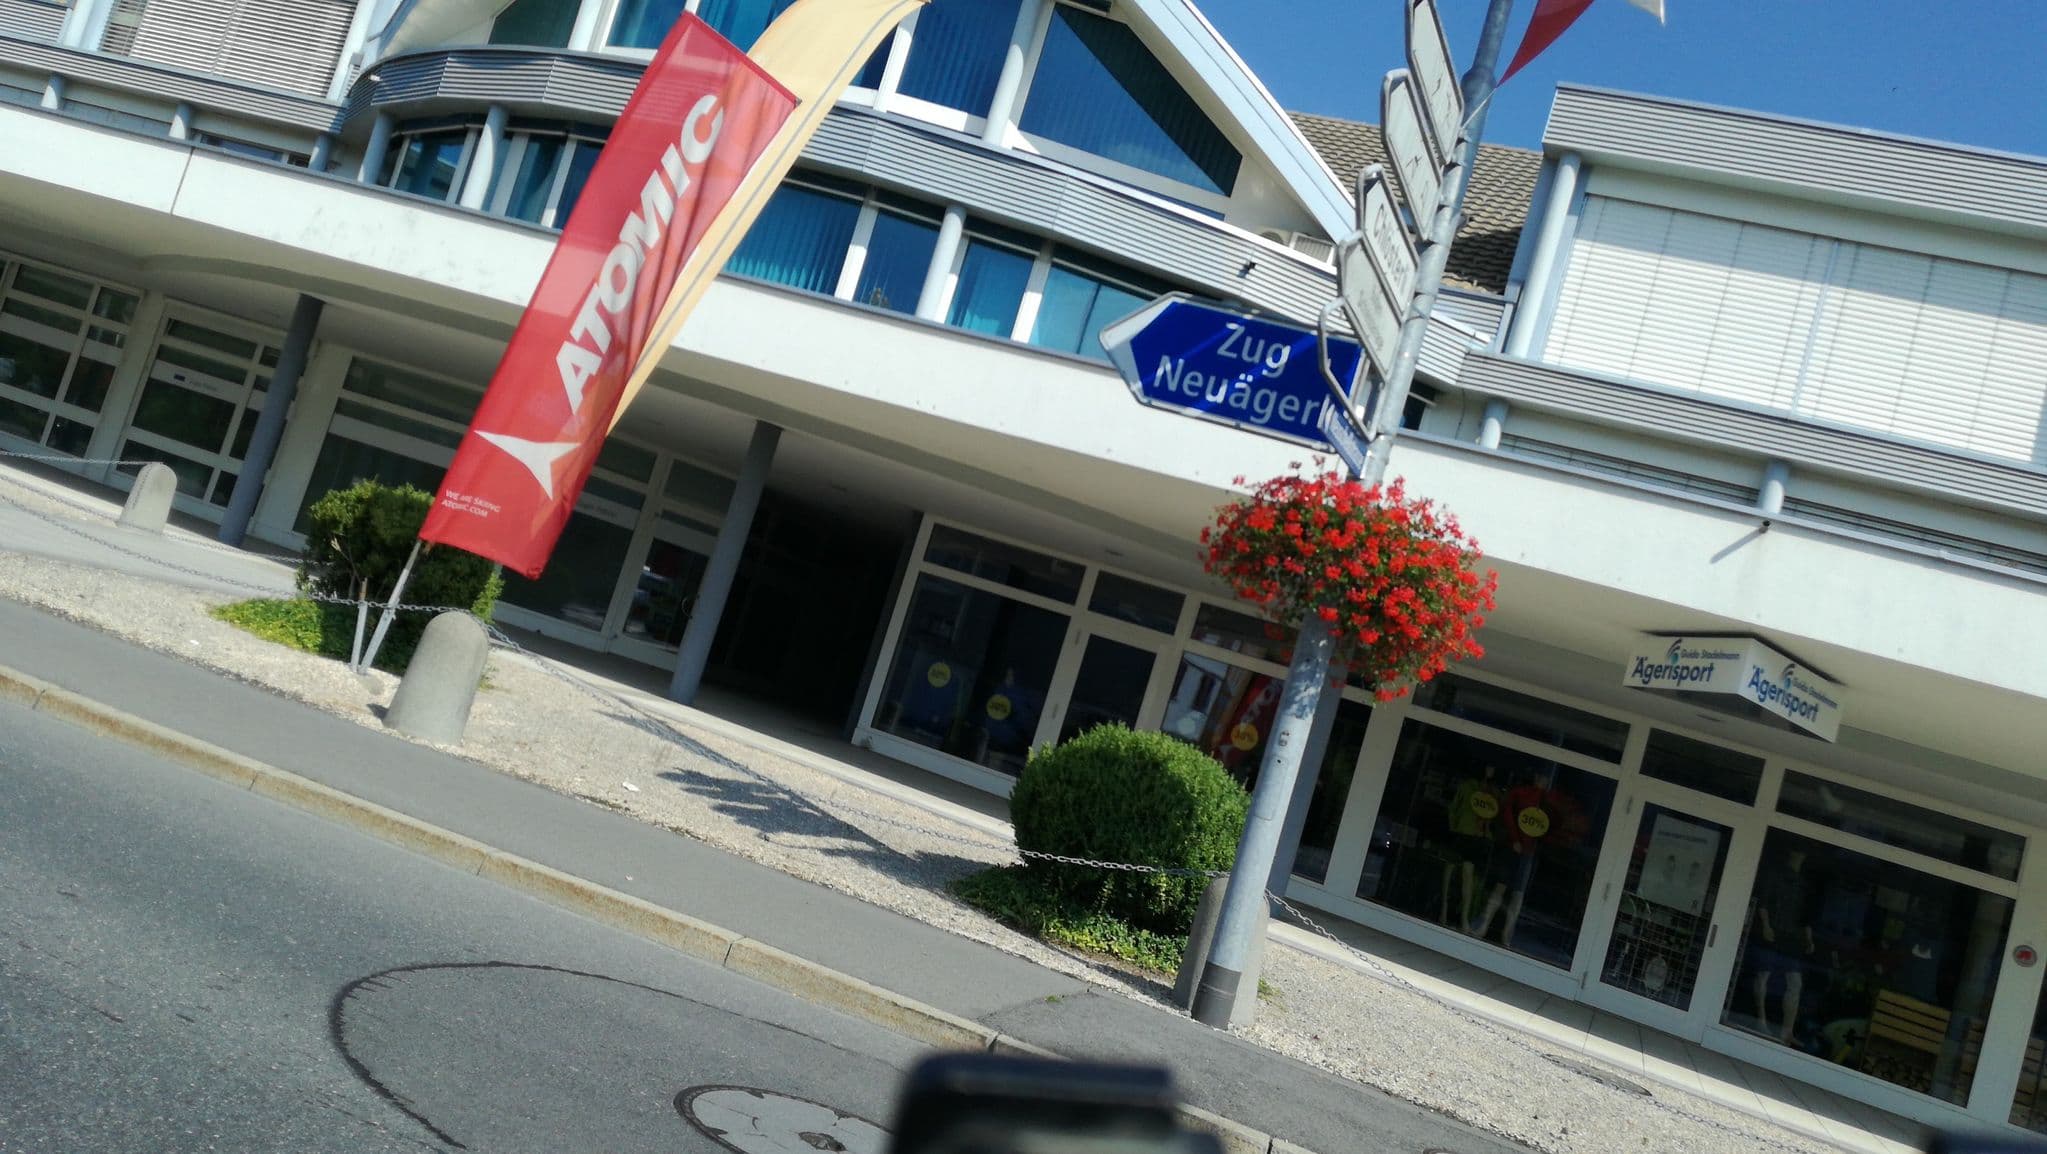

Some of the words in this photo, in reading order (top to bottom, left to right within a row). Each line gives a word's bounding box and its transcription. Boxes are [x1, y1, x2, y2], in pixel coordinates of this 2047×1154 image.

[555, 94, 725, 415] ATOMIC
[1217, 322, 1291, 378] Zug
[1631, 656, 1715, 686] Ägerisport
[1747, 664, 1819, 723] Ägerisport
[1521, 814, 1545, 830] 30%
